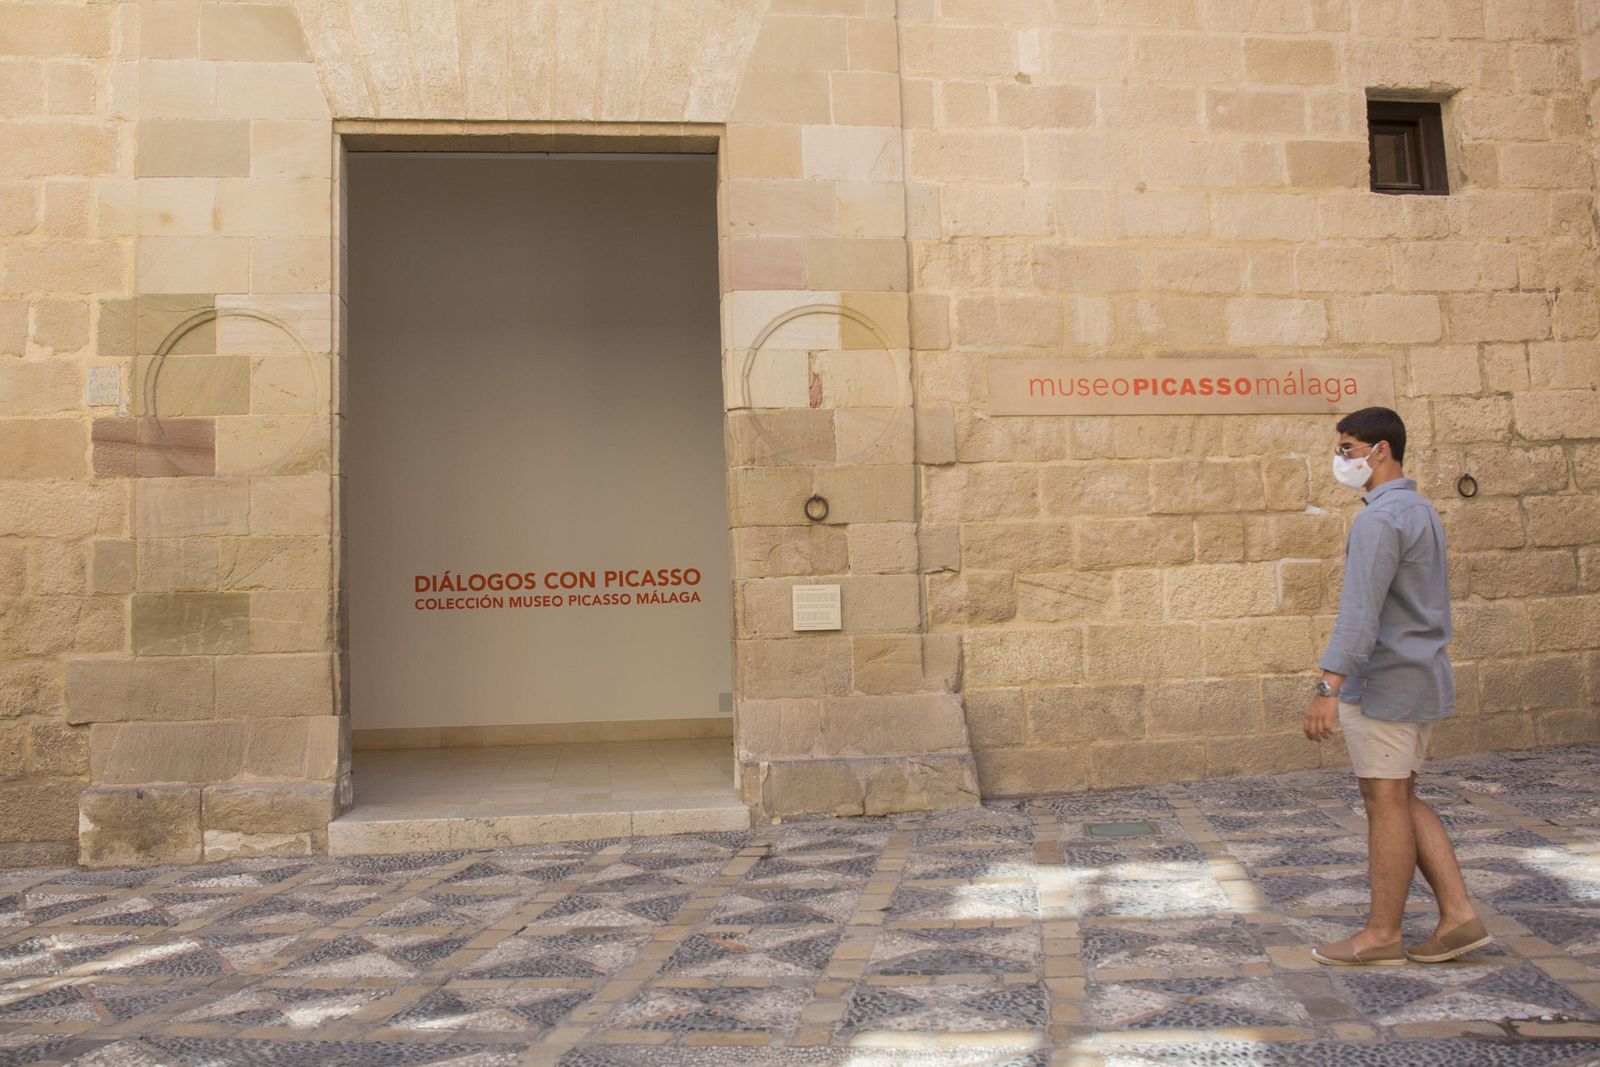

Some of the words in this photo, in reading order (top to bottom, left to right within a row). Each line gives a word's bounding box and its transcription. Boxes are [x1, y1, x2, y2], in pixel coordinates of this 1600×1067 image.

[415, 570, 536, 592] DIÁLOGOS
[543, 571, 595, 590] CON
[605, 568, 701, 588] PICASSO
[415, 594, 504, 610] COLECCIÓN
[509, 595, 563, 608] MUSEO
[569, 593, 631, 606] PICASSO
[636, 590, 701, 605] MÁLAGA
